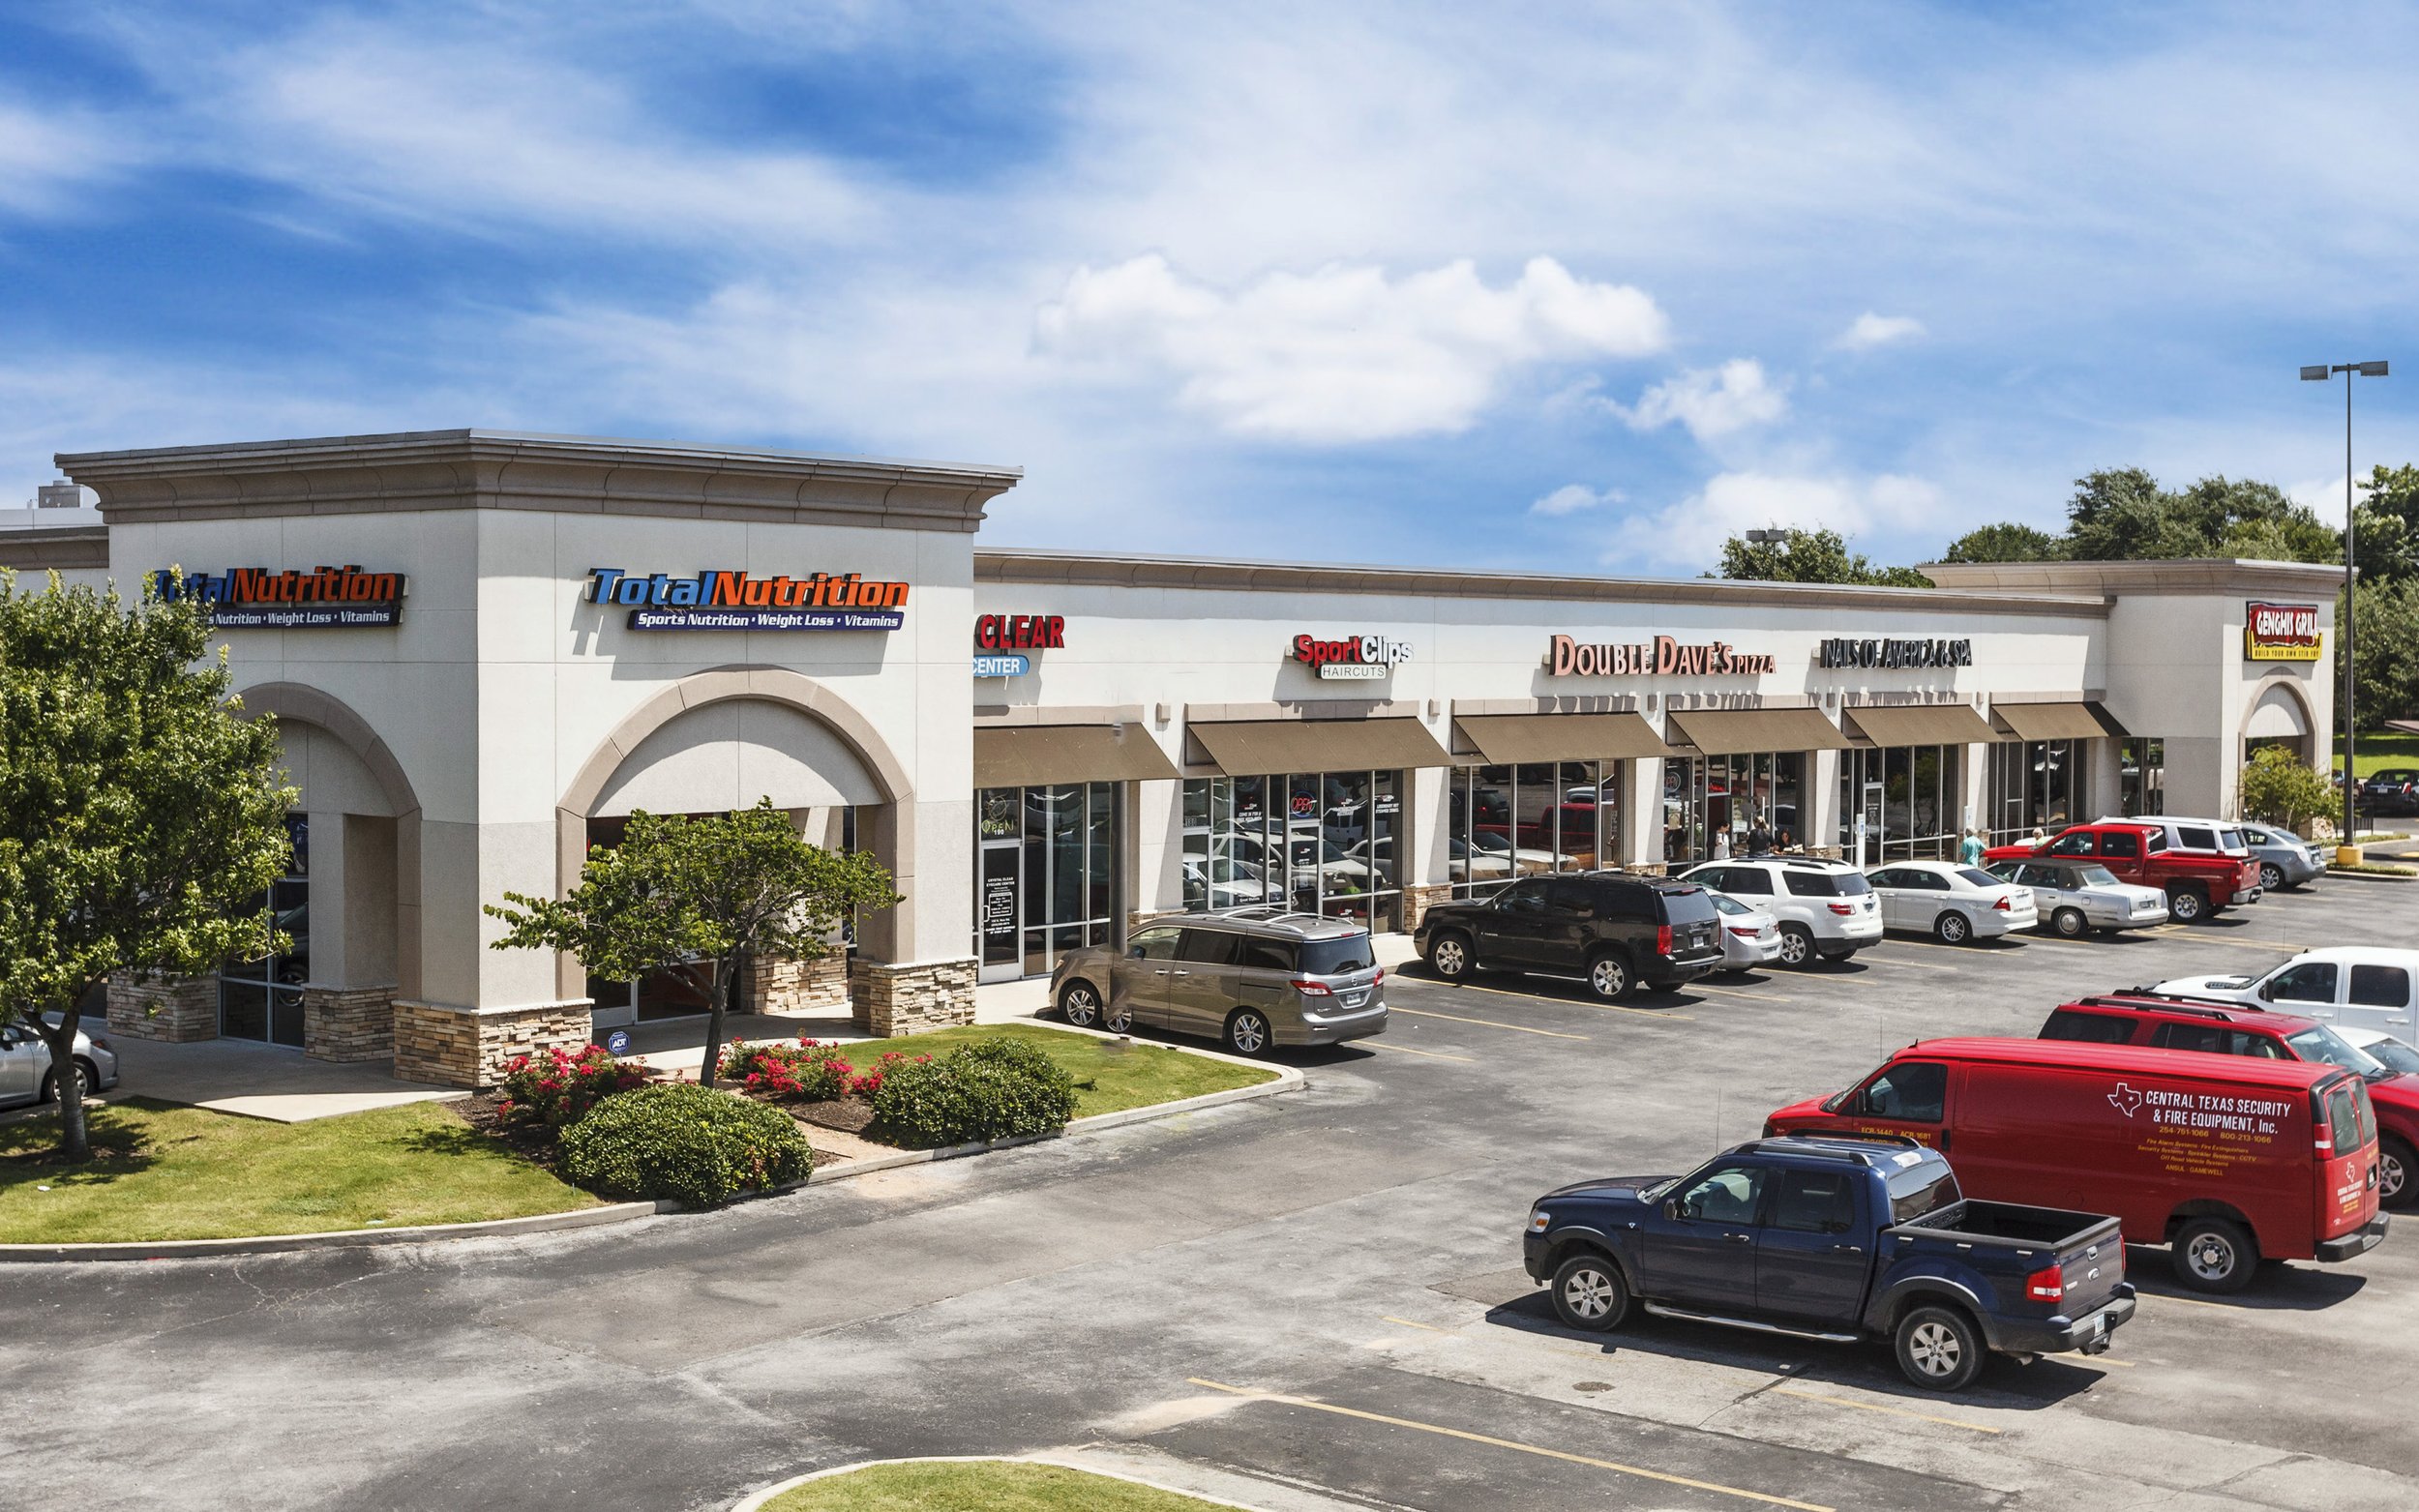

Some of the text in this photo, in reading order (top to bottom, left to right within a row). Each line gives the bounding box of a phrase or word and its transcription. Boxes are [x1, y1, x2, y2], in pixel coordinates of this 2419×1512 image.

[215, 611, 262, 624] Nutrition
[267, 611, 305, 627] Weight
[307, 611, 332, 624] Loss
[340, 610, 390, 622] Vitamins
[638, 612, 899, 628] Sports Nutrition Weight Loss Vitamins
[977, 614, 1064, 648] CLEAR
[2256, 610, 2319, 637] GENGHIS GRILL
[1552, 635, 1777, 675] DOUBLE DAVE'S PIZZA
[1822, 638, 1859, 668] NAILS
[1862, 639, 1881, 668] OF
[1882, 637, 1935, 669] AMERICA
[1951, 638, 1972, 667] SPA
[1323, 667, 1385, 677] HAIRCUTS
[1293, 798, 1312, 812] OPEN
[612, 1038, 626, 1049] ADT
[2146, 1090, 2291, 1117] CENTRAL TEXAS SECURITY
[2153, 1109, 2279, 1135] & FIRE EQUIPMENT, Inc.
